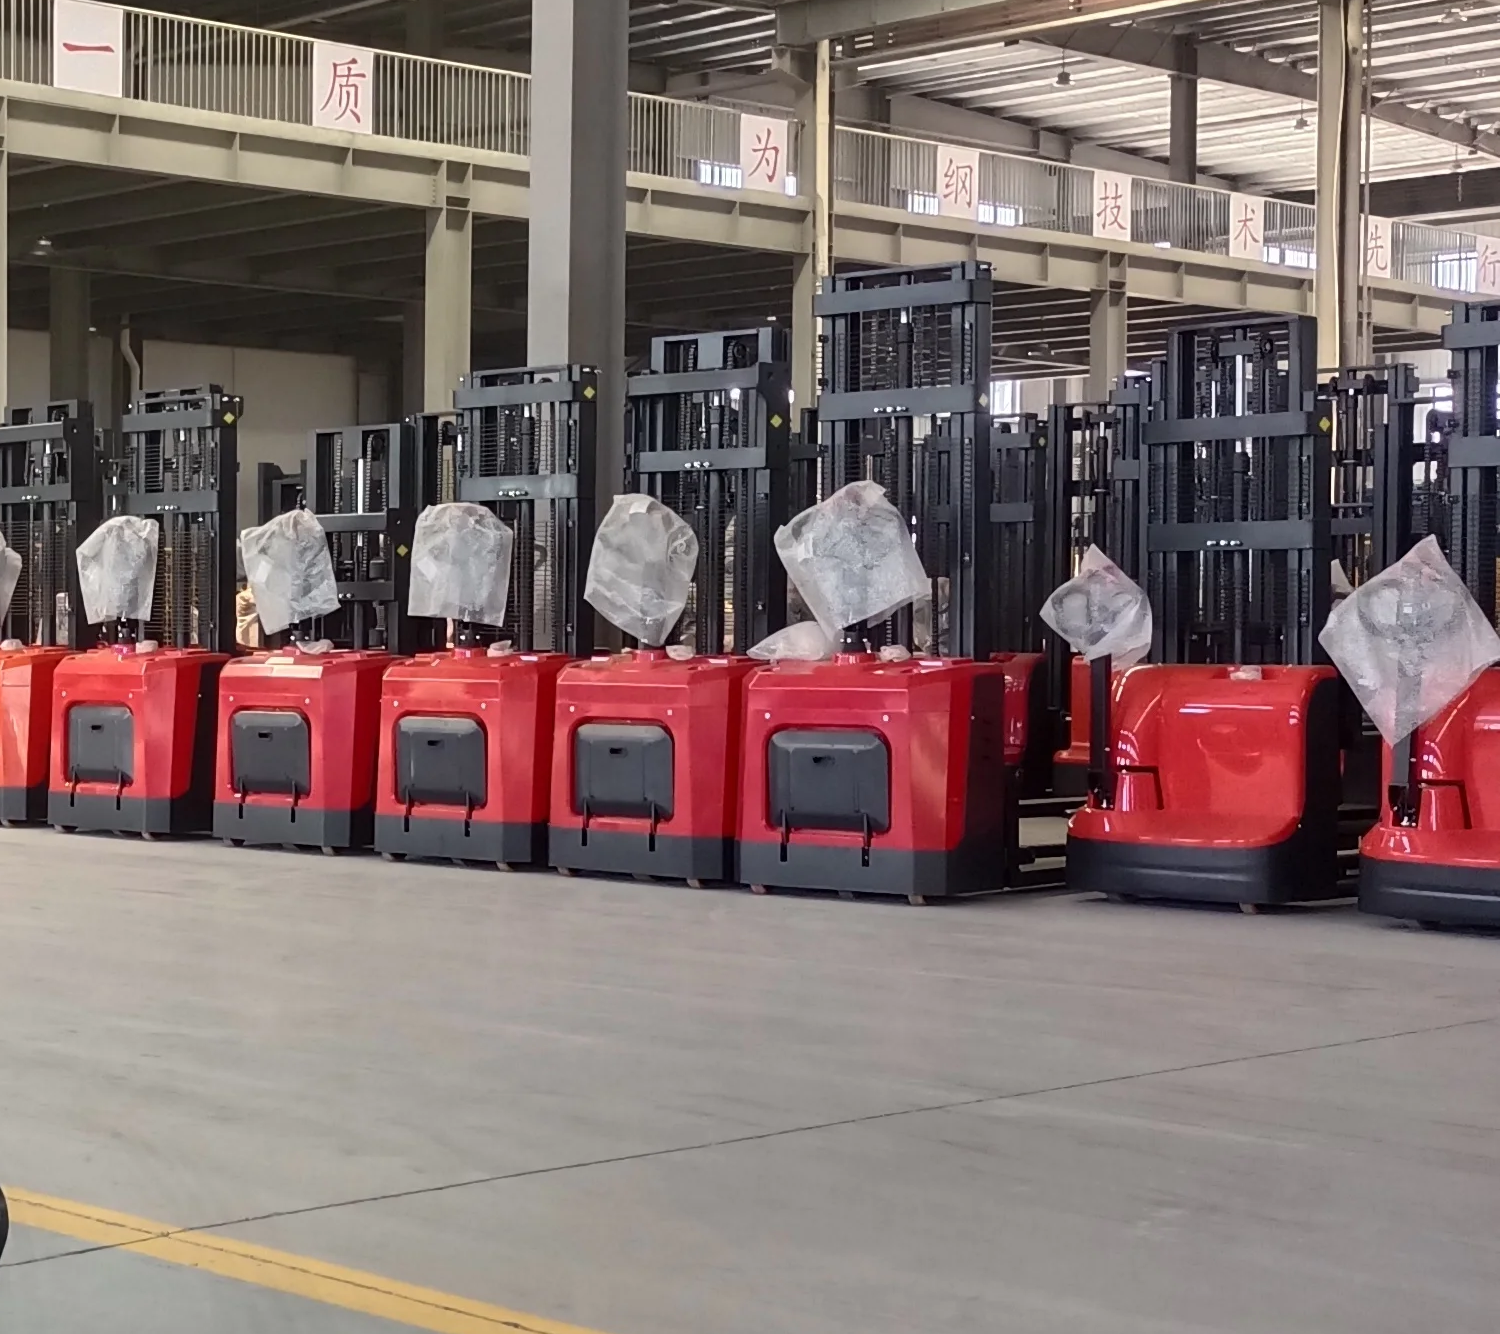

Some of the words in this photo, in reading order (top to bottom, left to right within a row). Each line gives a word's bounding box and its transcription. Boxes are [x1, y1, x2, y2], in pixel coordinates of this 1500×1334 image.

[62, 42, 115, 53] 一
[319, 57, 367, 124] 质
[747, 127, 780, 184] 为
[942, 157, 974, 209] 纲
[1096, 181, 1128, 230] 技
[1233, 202, 1260, 251] 术
[1366, 223, 1388, 271] 先
[1479, 244, 1500, 287] 行
